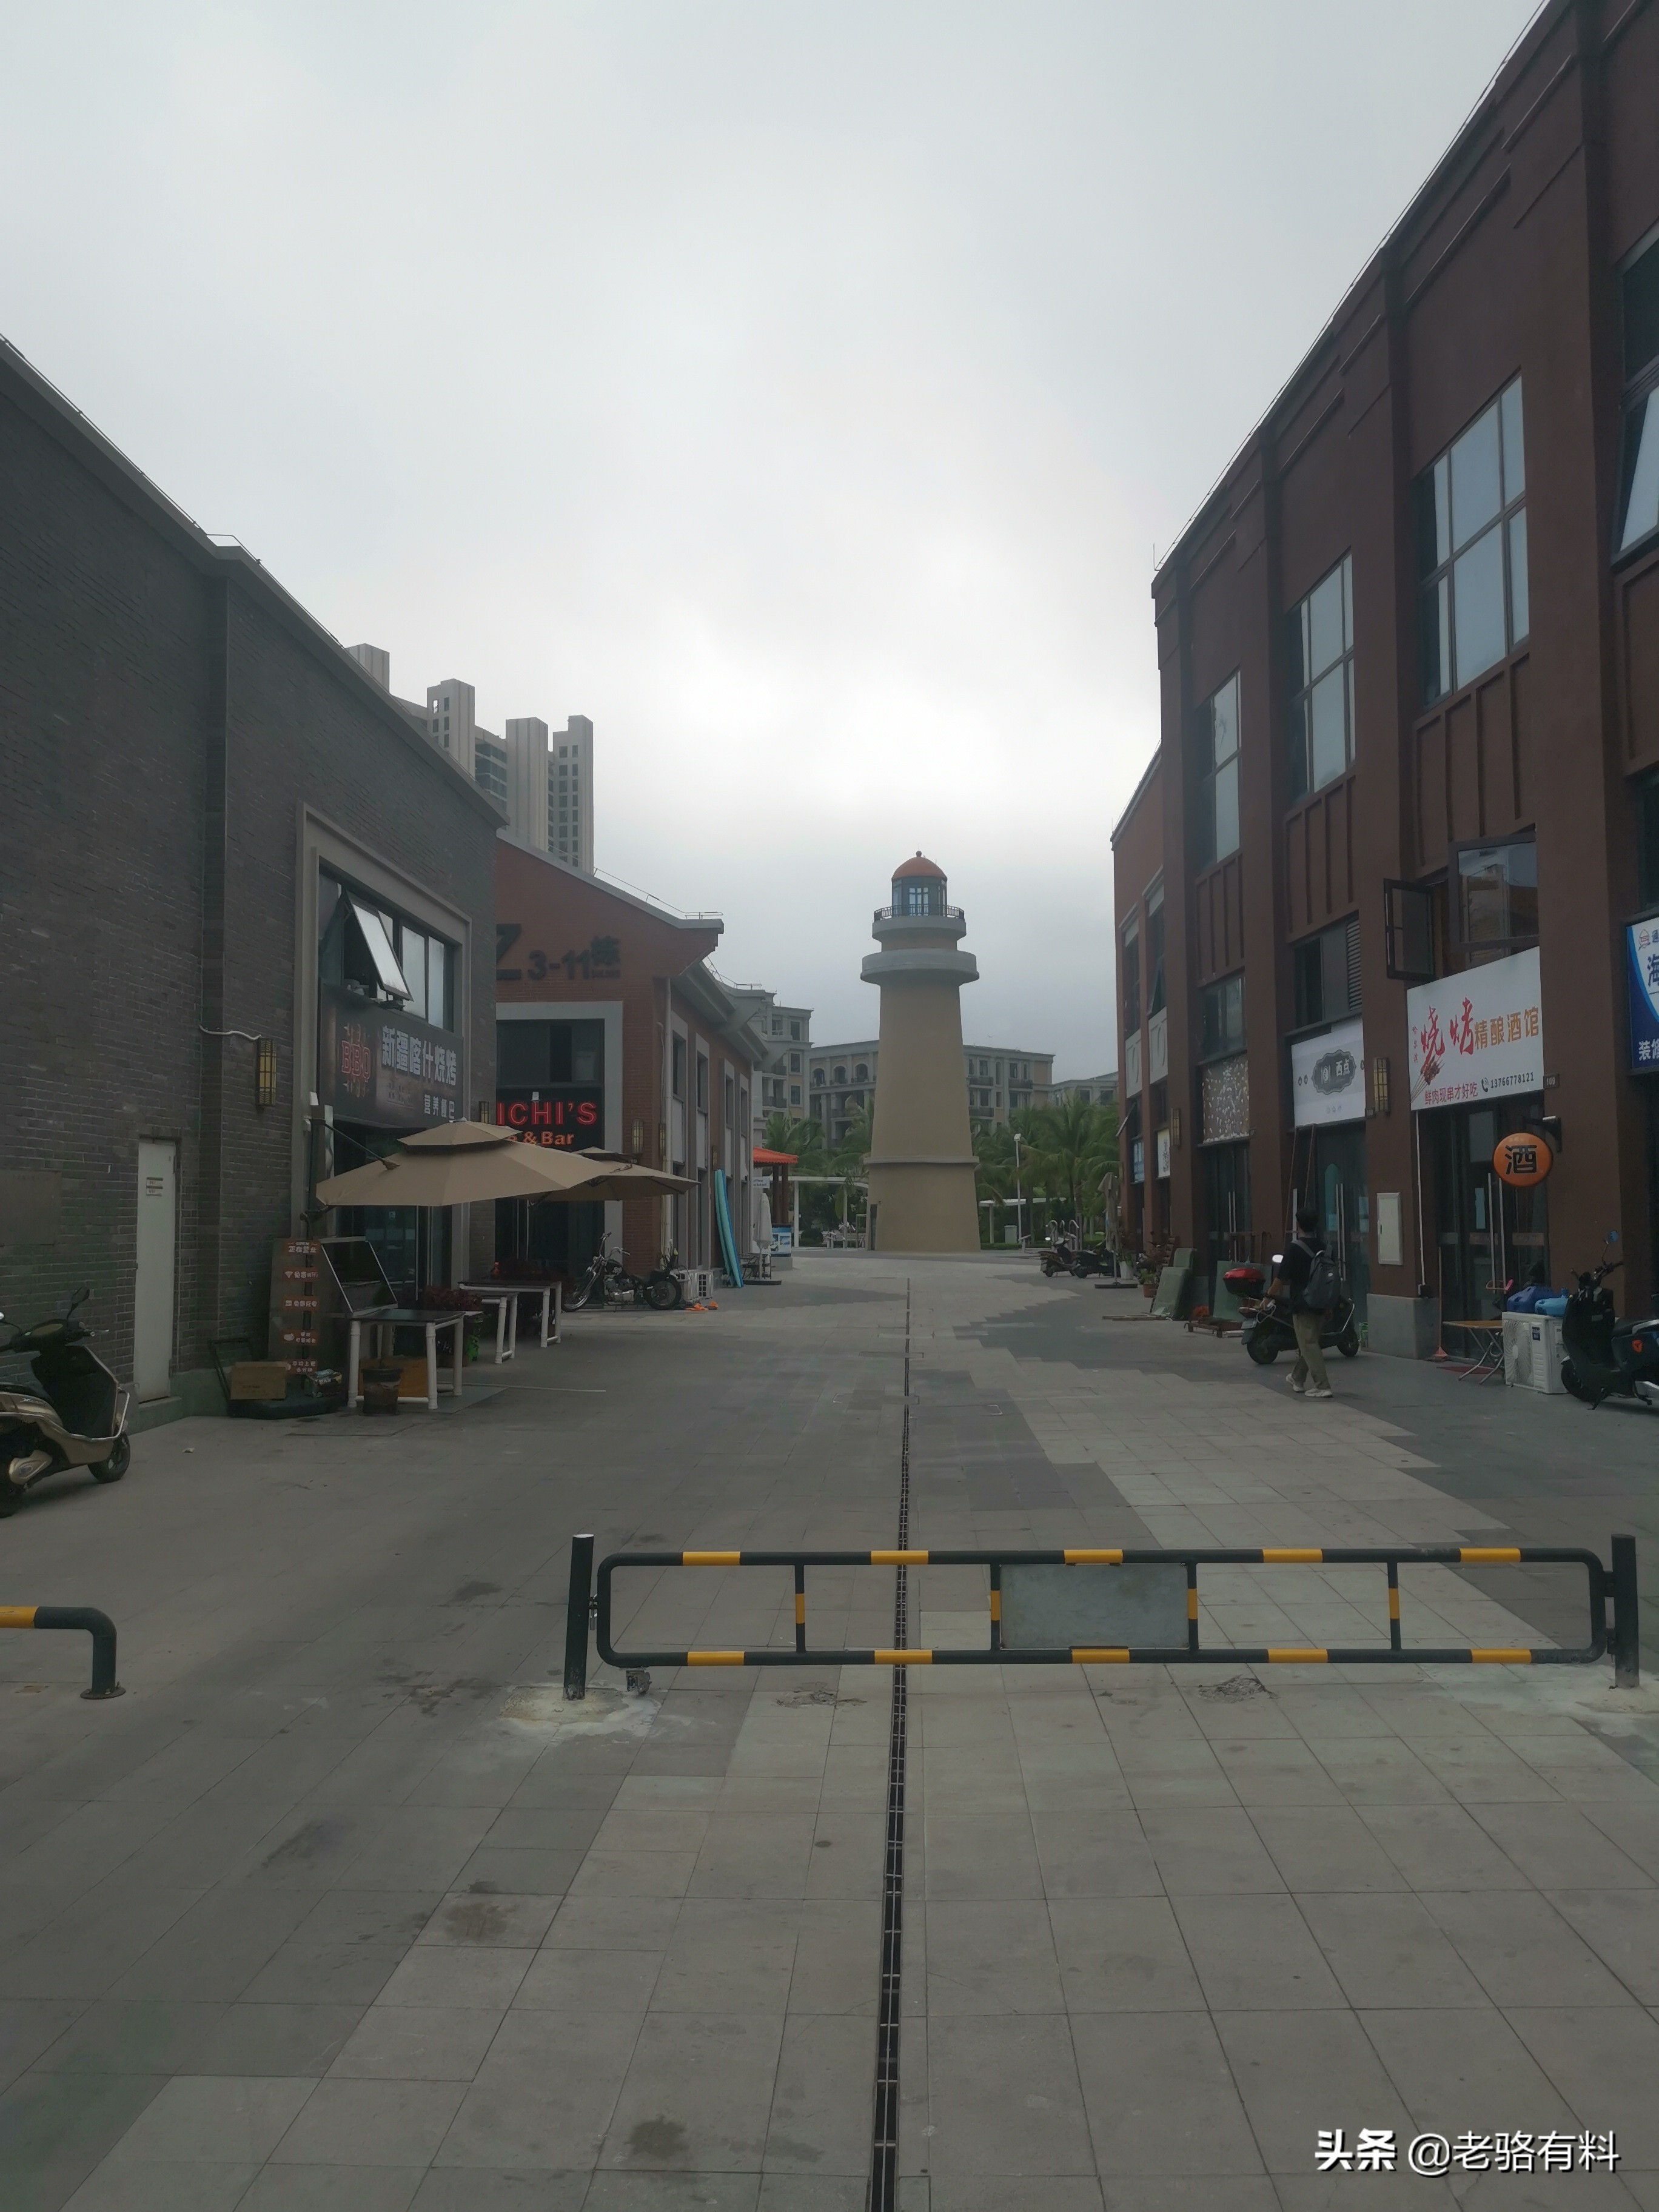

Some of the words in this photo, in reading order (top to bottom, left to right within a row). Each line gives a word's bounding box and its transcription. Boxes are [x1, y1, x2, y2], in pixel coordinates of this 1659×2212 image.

[341, 1040, 371, 1083] BBQ
[381, 1025, 457, 1086] 新疆喀什烧烤
[1638, 1039, 1659, 1061] 装修
[1336, 1057, 1351, 1077] 西点
[1491, 1071, 1534, 1089] 13766778121
[1425, 1081, 1478, 1105] 鲜肉现串才好吃
[540, 1130, 574, 1145] Bar
[1504, 1145, 1537, 1175] 酒
